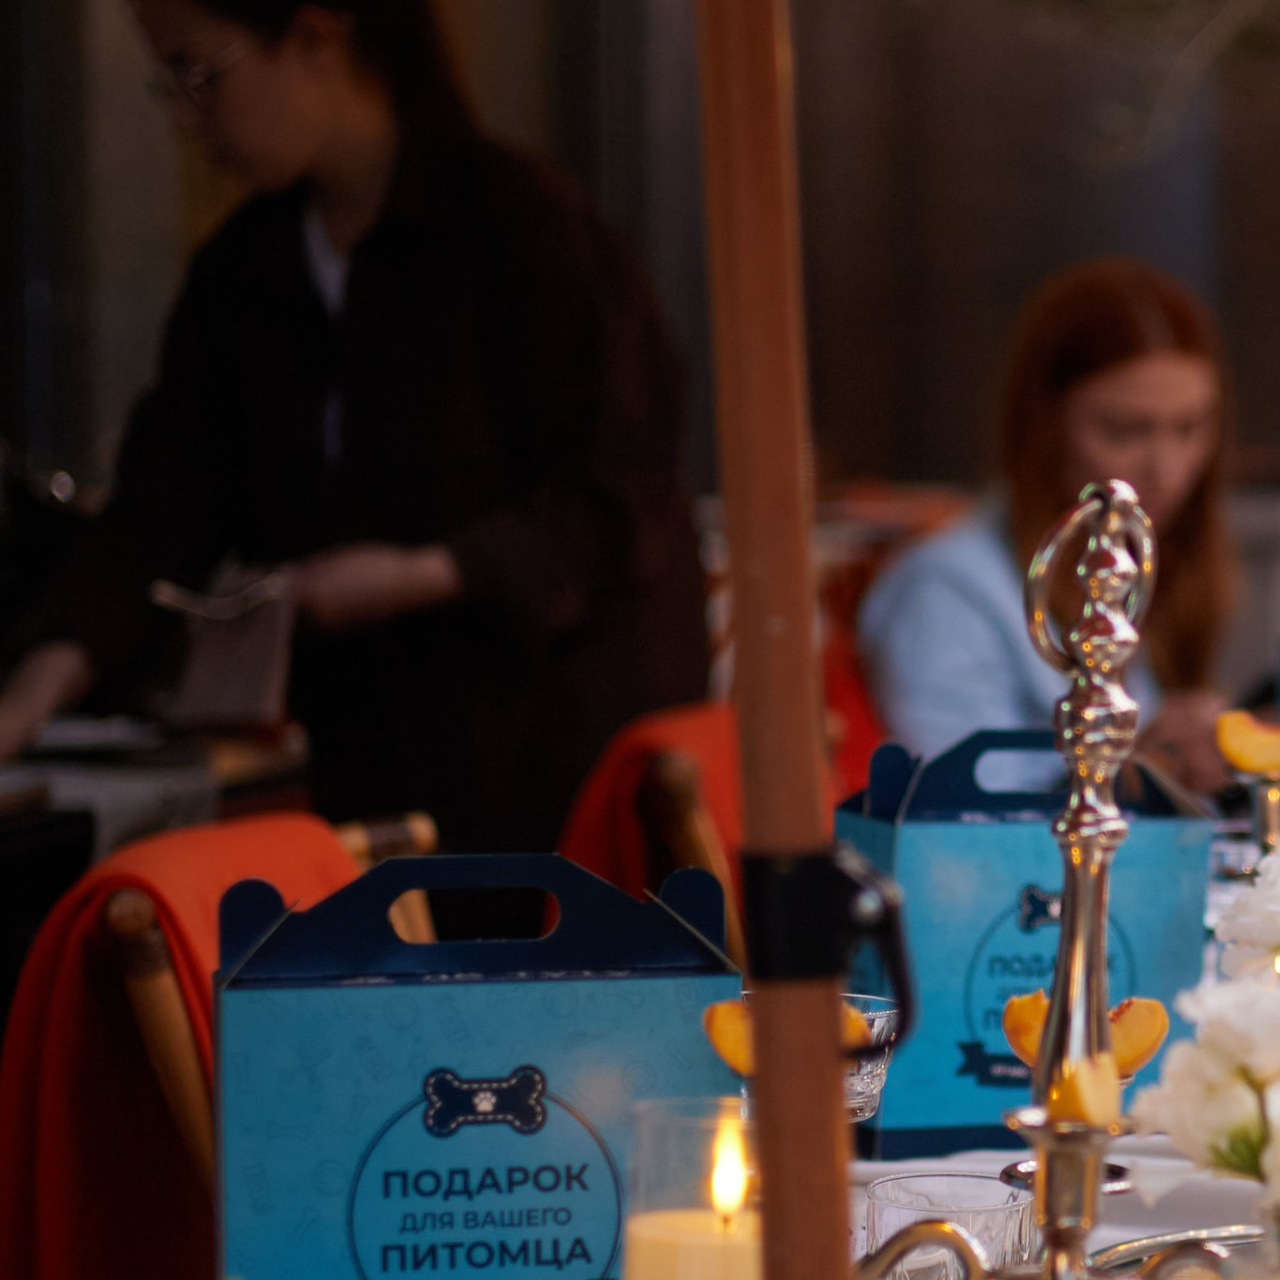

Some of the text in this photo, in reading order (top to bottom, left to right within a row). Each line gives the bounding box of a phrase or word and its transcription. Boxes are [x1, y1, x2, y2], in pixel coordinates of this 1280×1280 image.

[382, 1163, 590, 1201] ПОДАРОК
[399, 1206, 573, 1234] ДЛЯ ВАШЕГО
[380, 1237, 593, 1273] ПИТОМЦА
